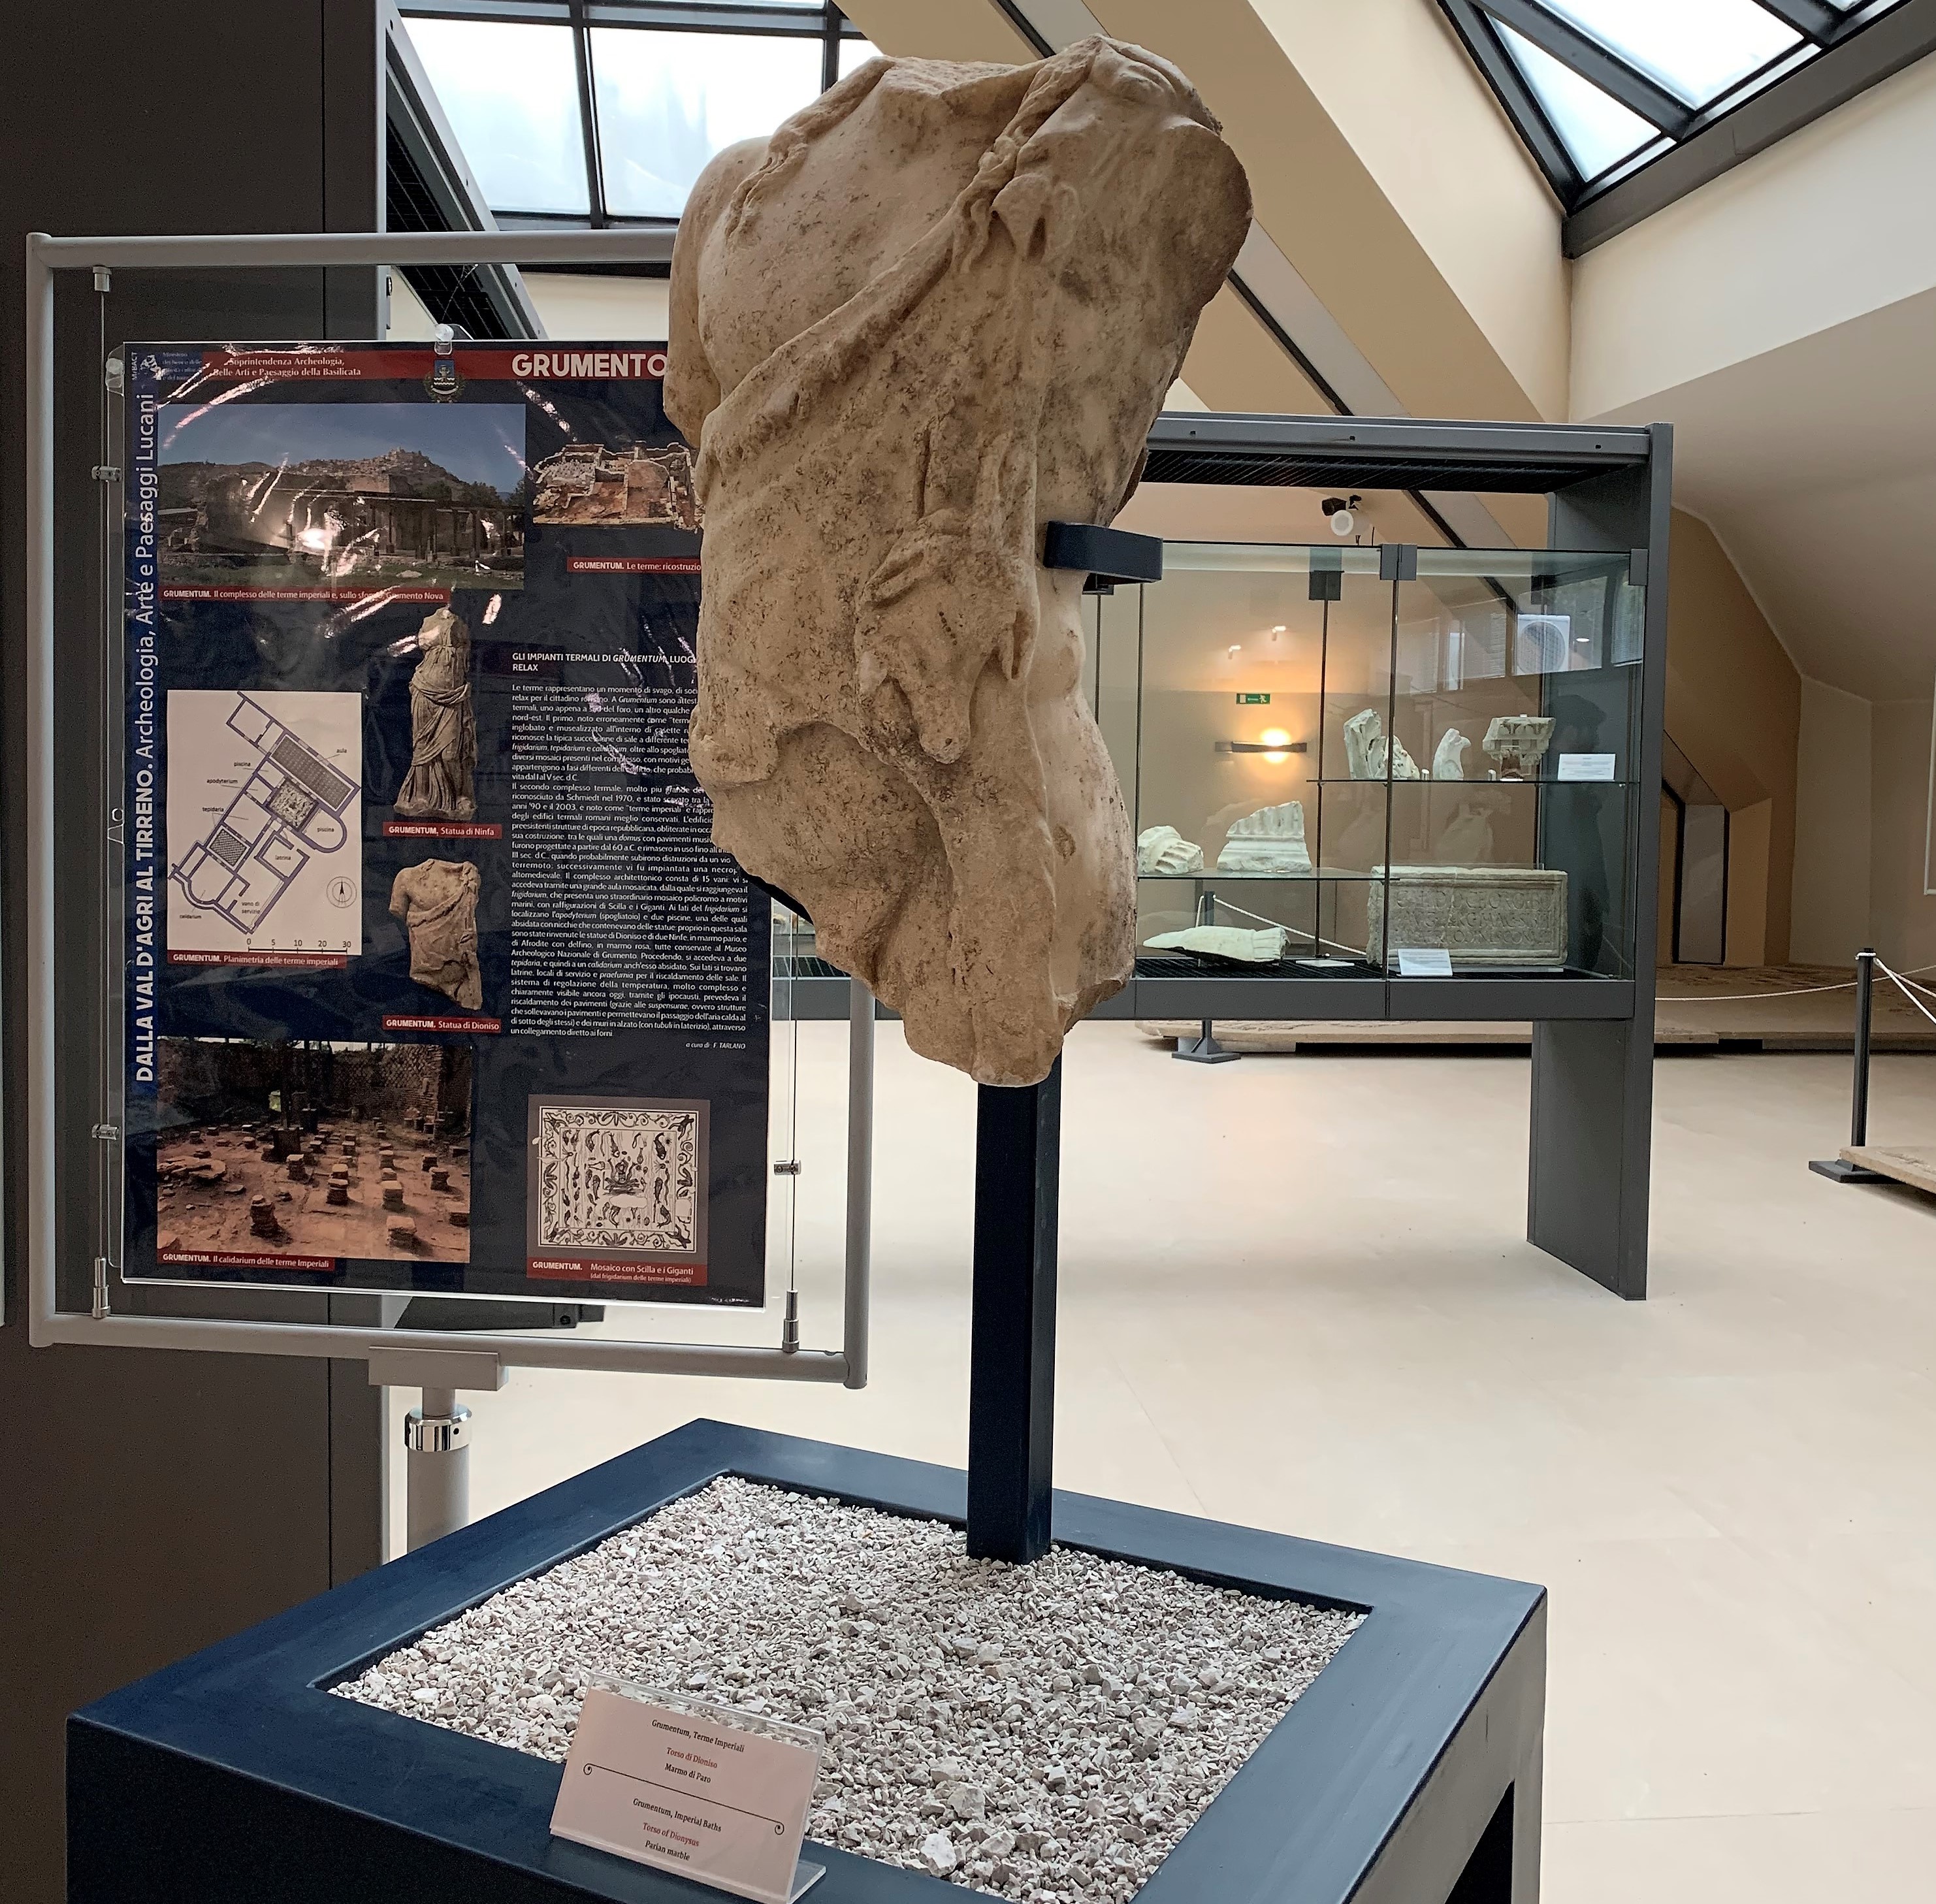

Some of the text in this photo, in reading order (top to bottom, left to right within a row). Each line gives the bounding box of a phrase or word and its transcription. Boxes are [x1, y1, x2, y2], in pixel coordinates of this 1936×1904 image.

[294, 357, 344, 366] Archeologia,
[512, 353, 668, 377] GRUMENTO
[259, 368, 298, 378] Paesaggio
[219, 590, 257, 599] complesso
[299, 590, 330, 600] imperiali
[136, 393, 158, 1082] DALLA VAL D'AGRI AL TIRRENO. Archeologia, Arte e Paesaggi Lucani
[666, 1267, 693, 1276] Giganti
[652, 1719, 745, 1752] Grumentum, Terme Imperiali
[667, 1747, 684, 1758] Torso
[693, 1755, 717, 1768] Dioniso
[665, 1763, 687, 1775] Marmo
[696, 1772, 711, 1783] Paro
[633, 1798, 722, 1832] Grumentum, Imperial Baths
[643, 1822, 660, 1833] Torso
[670, 1831, 700, 1847] Dionysus
[645, 1840, 689, 1860] Parian marble
